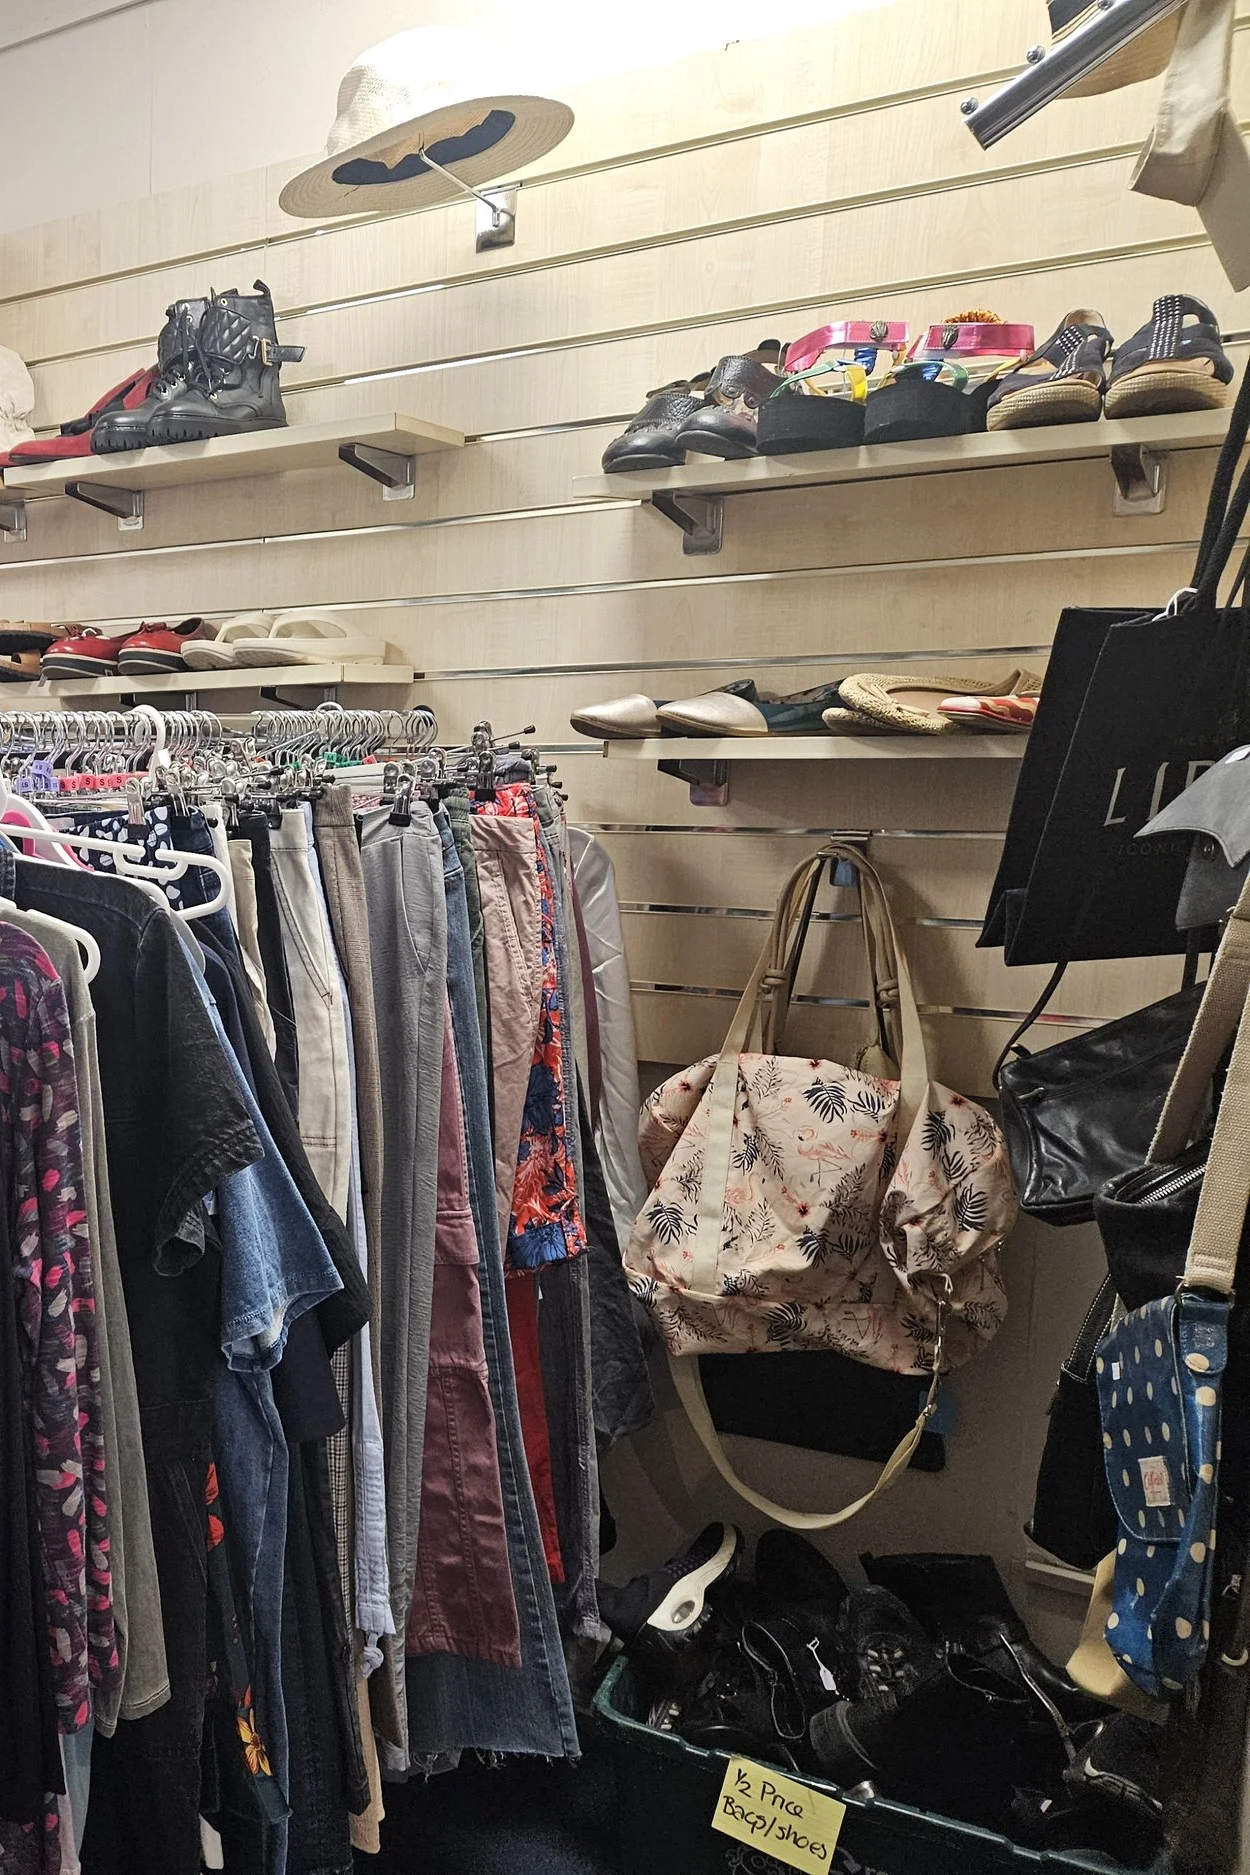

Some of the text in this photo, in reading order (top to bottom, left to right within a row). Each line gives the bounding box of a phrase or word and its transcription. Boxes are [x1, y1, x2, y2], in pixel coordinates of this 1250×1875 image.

[71, 780, 76, 788] S
[85, 777, 91, 785] S
[99, 778, 105, 786] S
